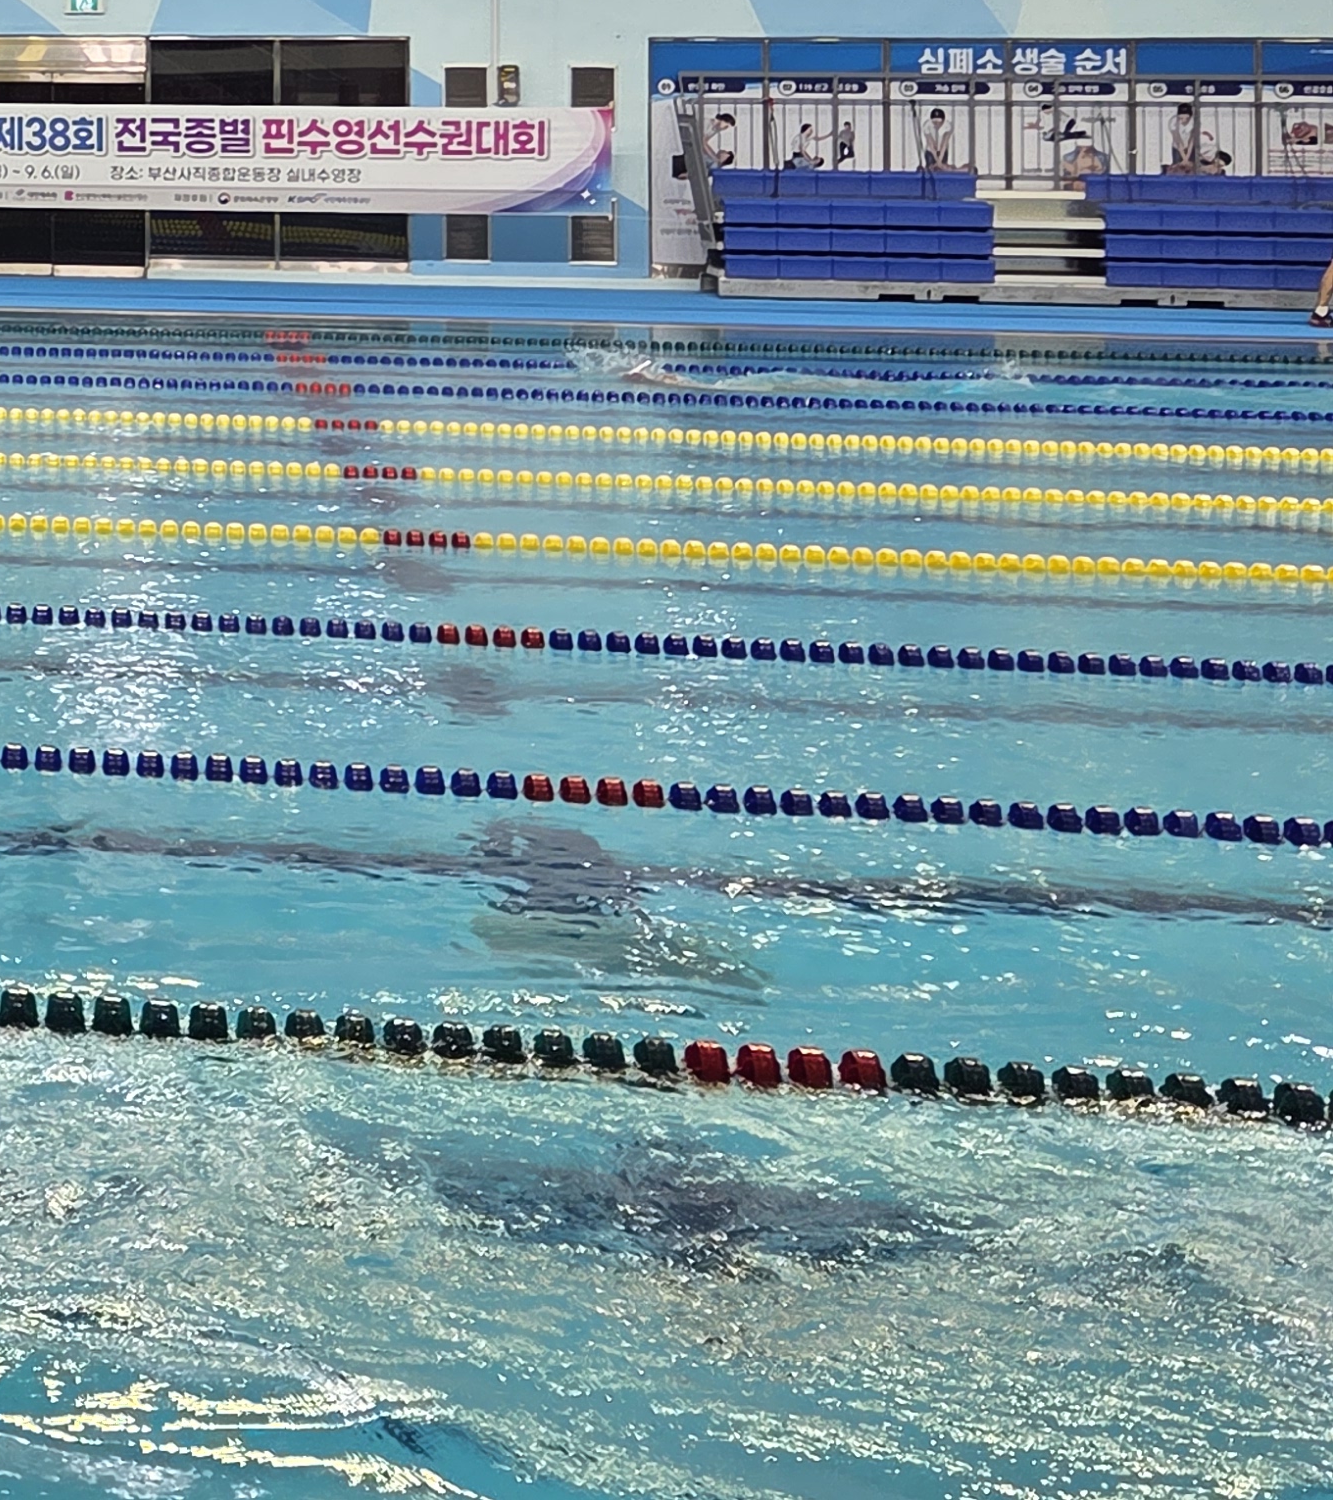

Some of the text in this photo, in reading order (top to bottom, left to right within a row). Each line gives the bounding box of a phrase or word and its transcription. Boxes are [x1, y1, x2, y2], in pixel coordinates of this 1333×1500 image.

[1074, 47, 1127, 76] 순서
[113, 116, 251, 154] 전국종별
[261, 117, 546, 156] 핀수영선수권대회
[24, 164, 37, 179] 9.
[109, 165, 144, 181] 장소:
[147, 166, 281, 182] 부산사직종합운동장
[286, 167, 362, 184] 실내수영장
